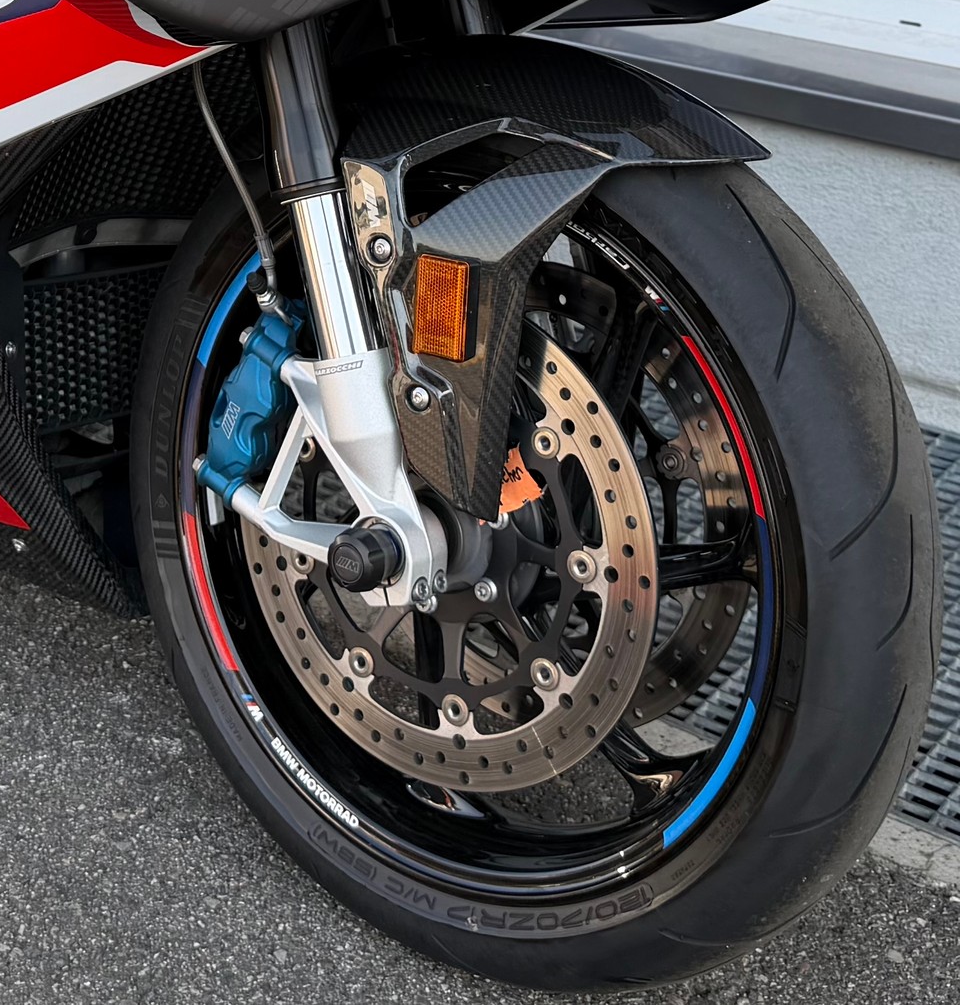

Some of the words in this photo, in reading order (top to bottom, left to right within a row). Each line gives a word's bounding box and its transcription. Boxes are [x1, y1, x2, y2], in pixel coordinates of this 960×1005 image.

[315, 360, 362, 375] ARZOCCHI
[154, 333, 187, 478] DUNLOP
[270, 736, 301, 771] BMW
[295, 767, 360, 829] MOTORRAD
[383, 875, 438, 911] M/C
